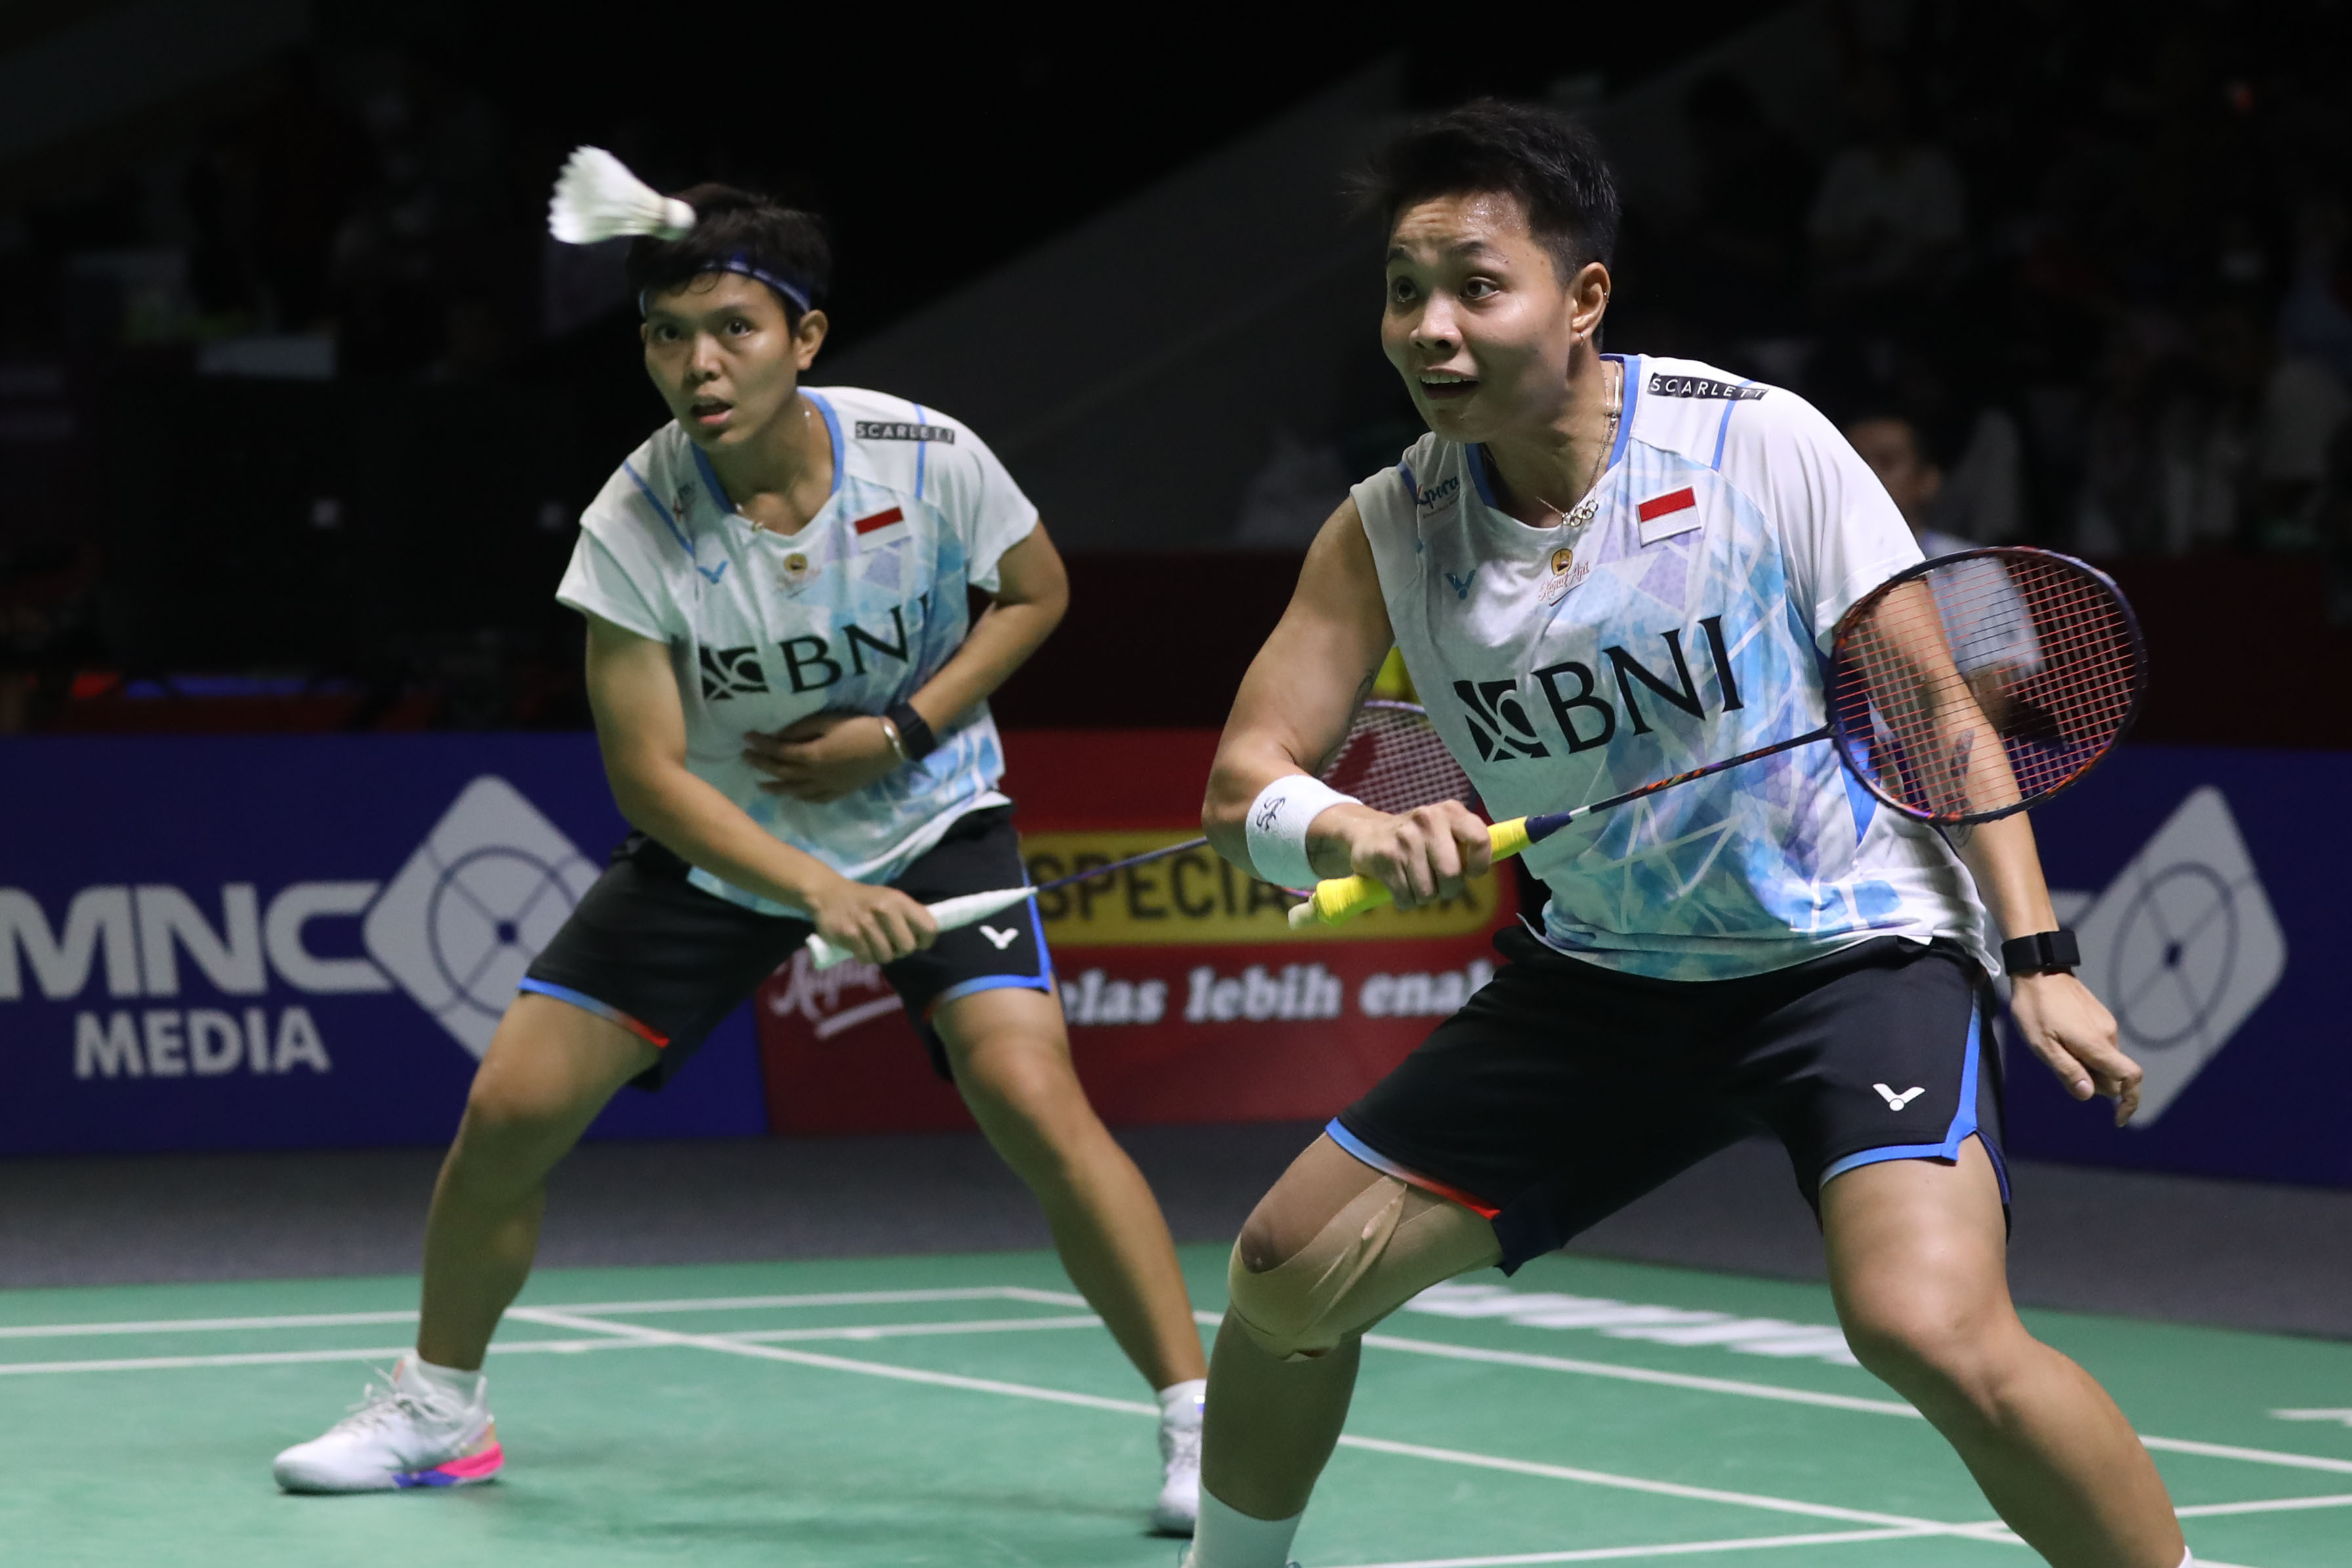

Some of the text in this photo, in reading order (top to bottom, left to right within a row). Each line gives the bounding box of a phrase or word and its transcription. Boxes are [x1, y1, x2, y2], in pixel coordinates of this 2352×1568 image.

[1650, 378, 1767, 398] SCARLETT
[779, 593, 928, 693] BNI
[1531, 615, 1744, 754] BNI
[1028, 853, 1291, 921] SPECIA
[0, 880, 395, 1000] MNC
[1184, 963, 1342, 1023] lebih
[74, 1006, 331, 1079] MEDIA
